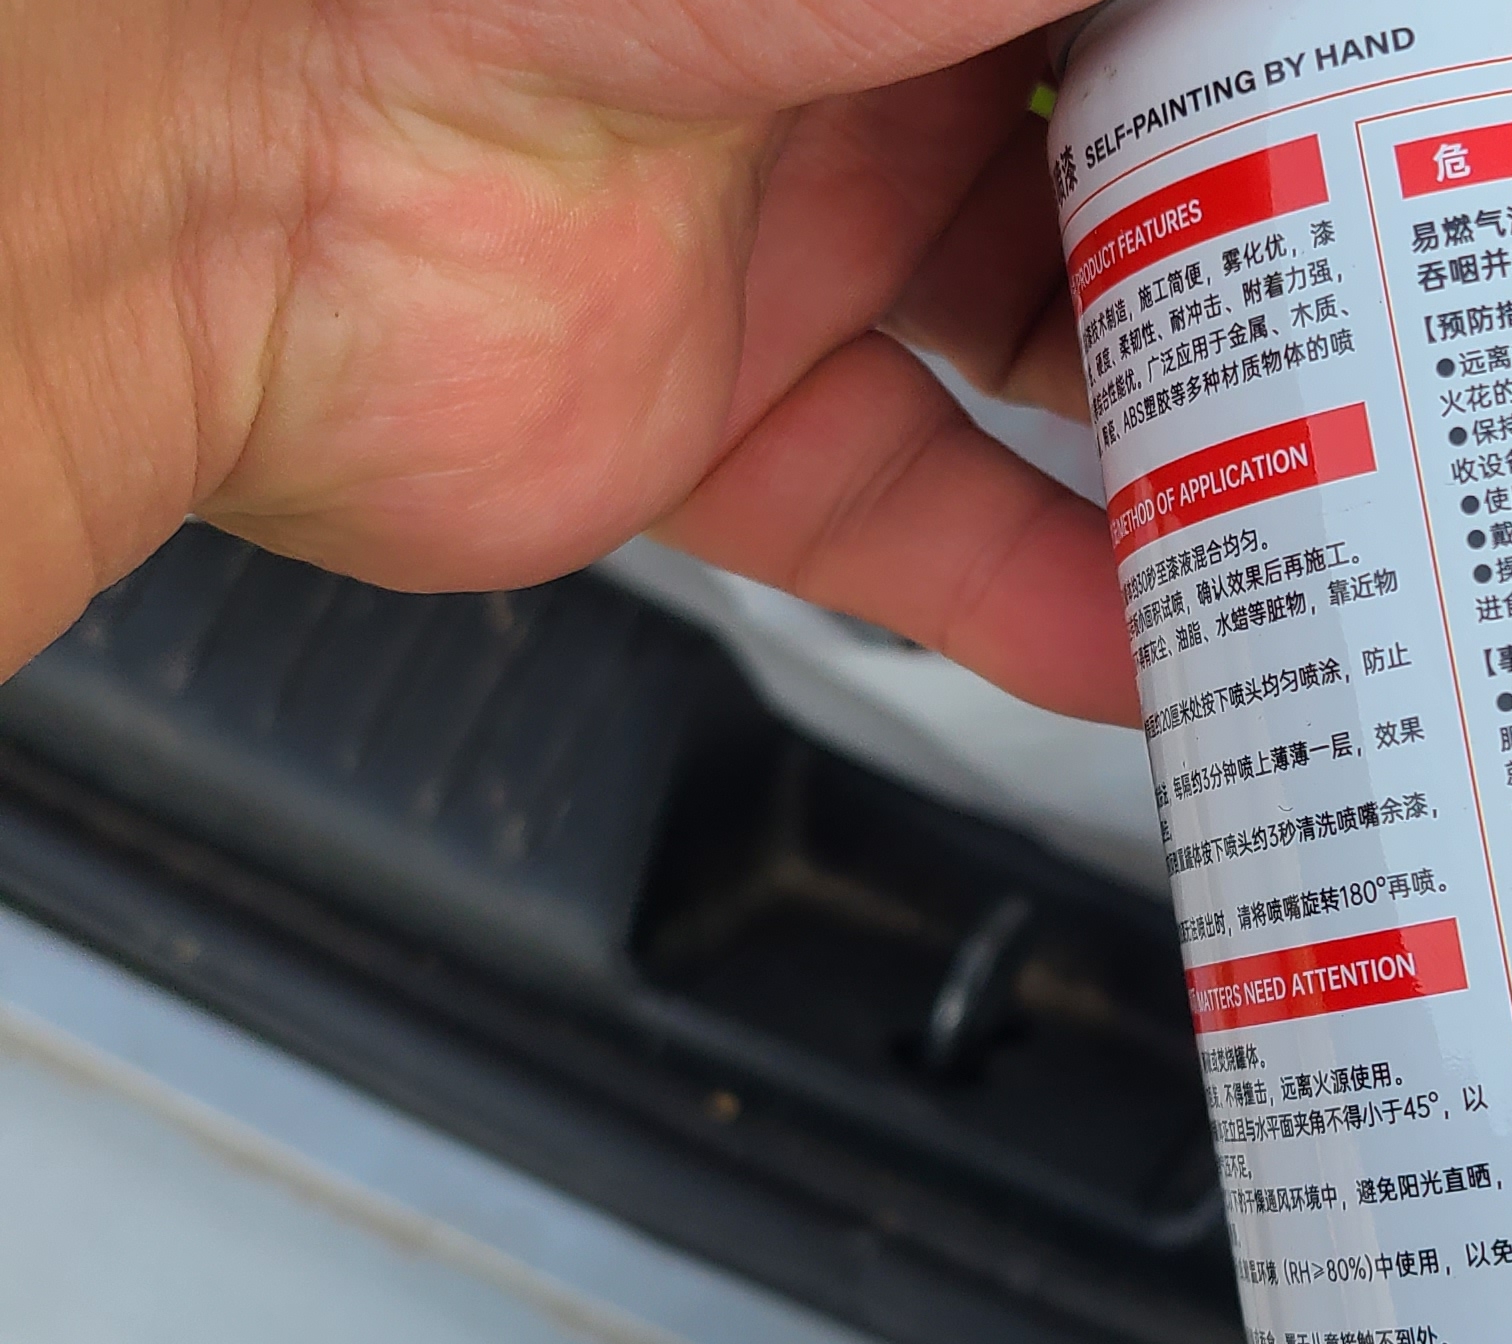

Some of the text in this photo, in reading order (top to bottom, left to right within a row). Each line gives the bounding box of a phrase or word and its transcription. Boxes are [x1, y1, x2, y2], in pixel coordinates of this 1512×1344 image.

[1085, 70, 1257, 169] SELF-PAINTING
[1264, 53, 1305, 87] BY
[1315, 27, 1416, 72] HAND
[1118, 199, 1203, 255] FEATURES
[1157, 487, 1175, 515] OF
[1179, 443, 1309, 506] APPLICATION
[1243, 975, 1286, 1004] NEED
[1291, 952, 1417, 995] ATTENTION
